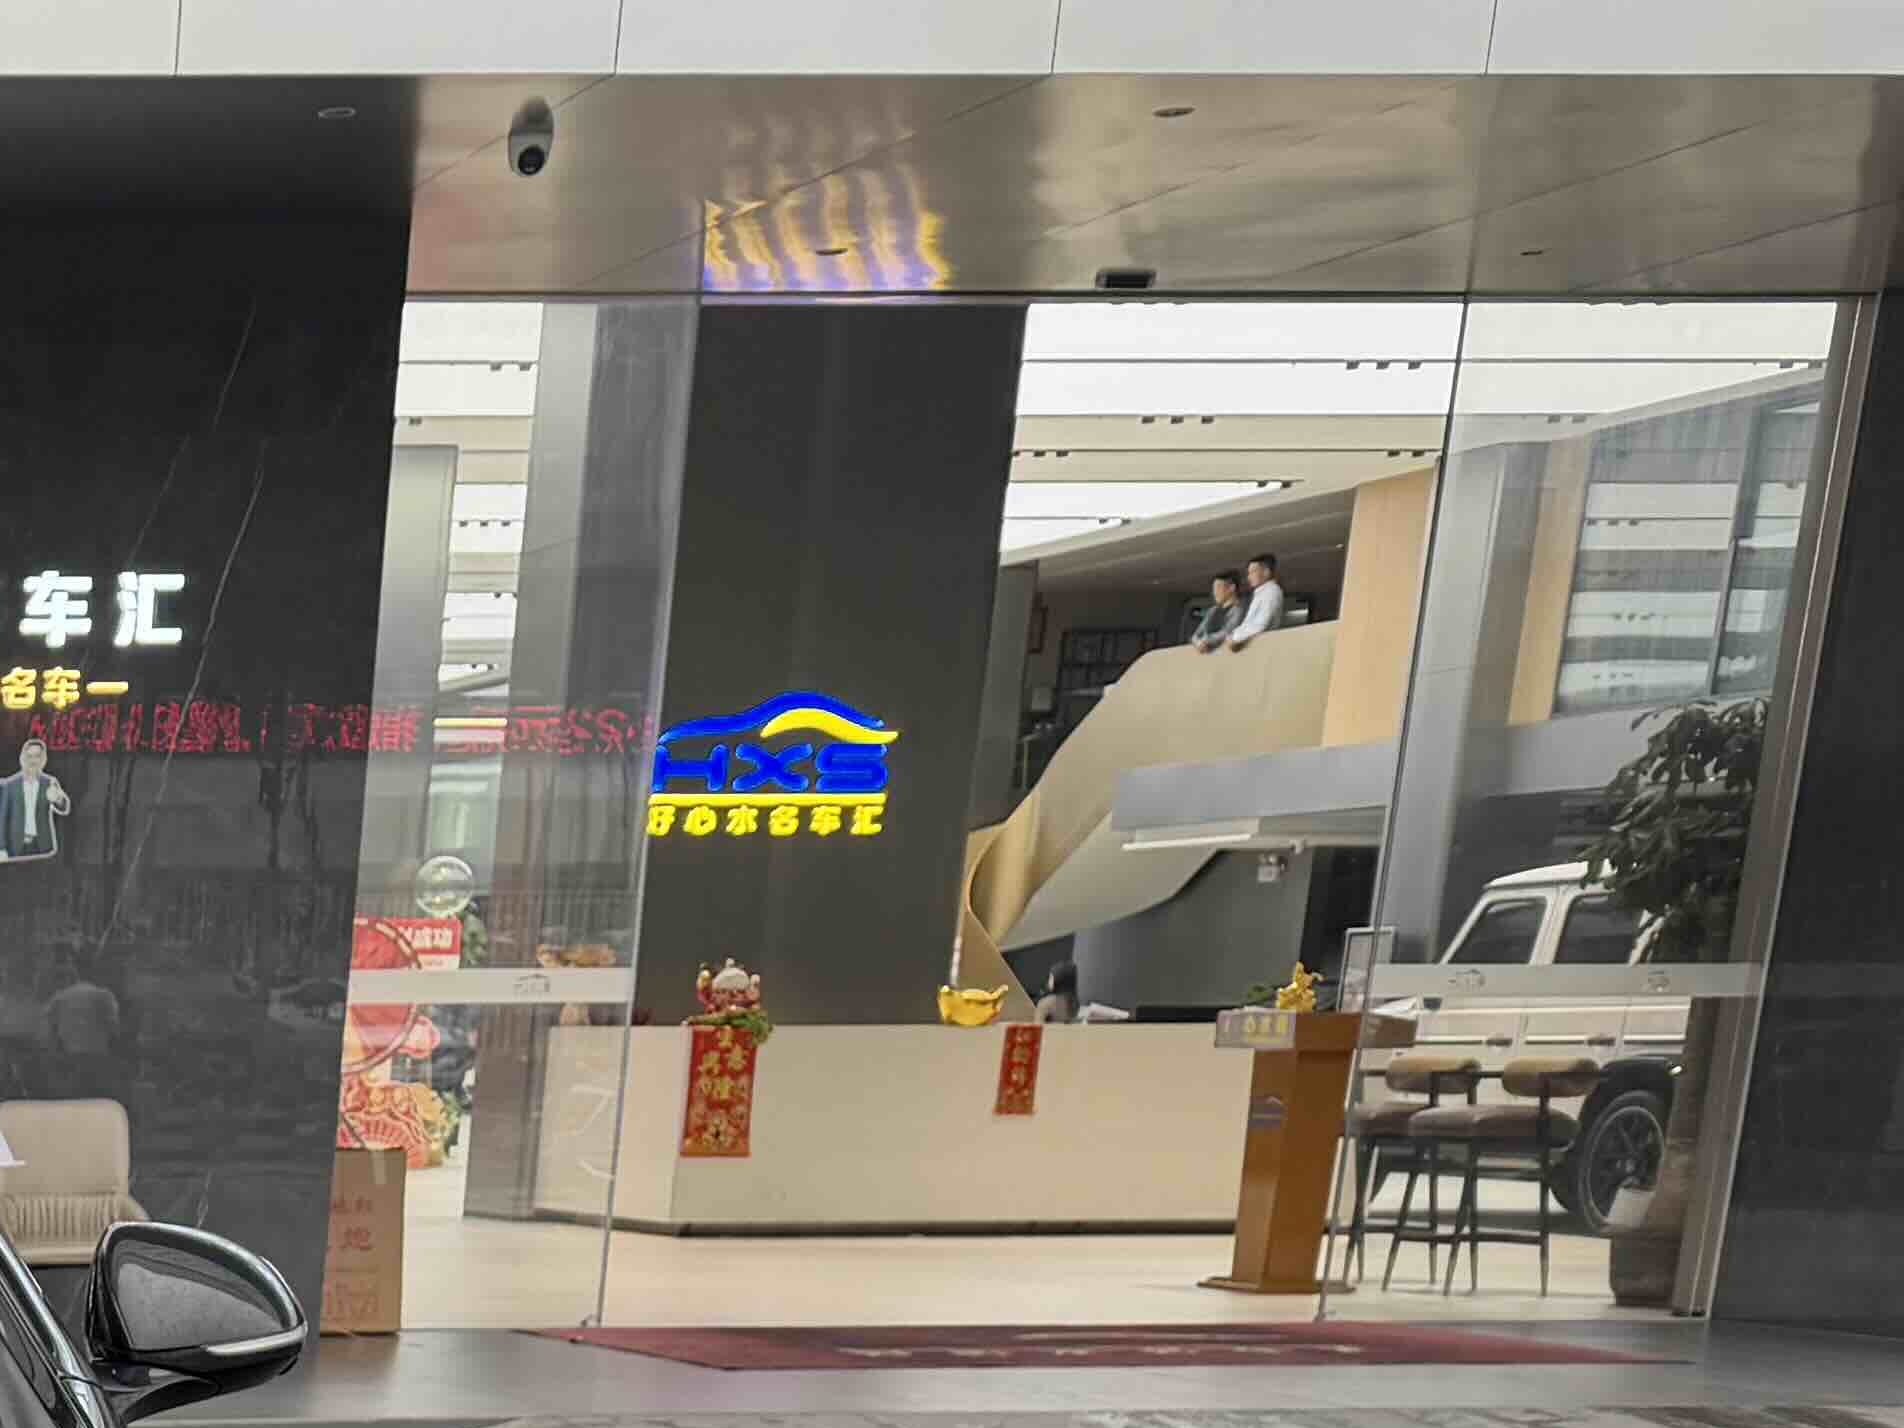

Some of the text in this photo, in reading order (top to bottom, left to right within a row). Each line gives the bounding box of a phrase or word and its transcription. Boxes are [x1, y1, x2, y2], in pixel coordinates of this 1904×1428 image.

[651, 743, 889, 792] HXS
[646, 805, 884, 837] 好心水名车汇
